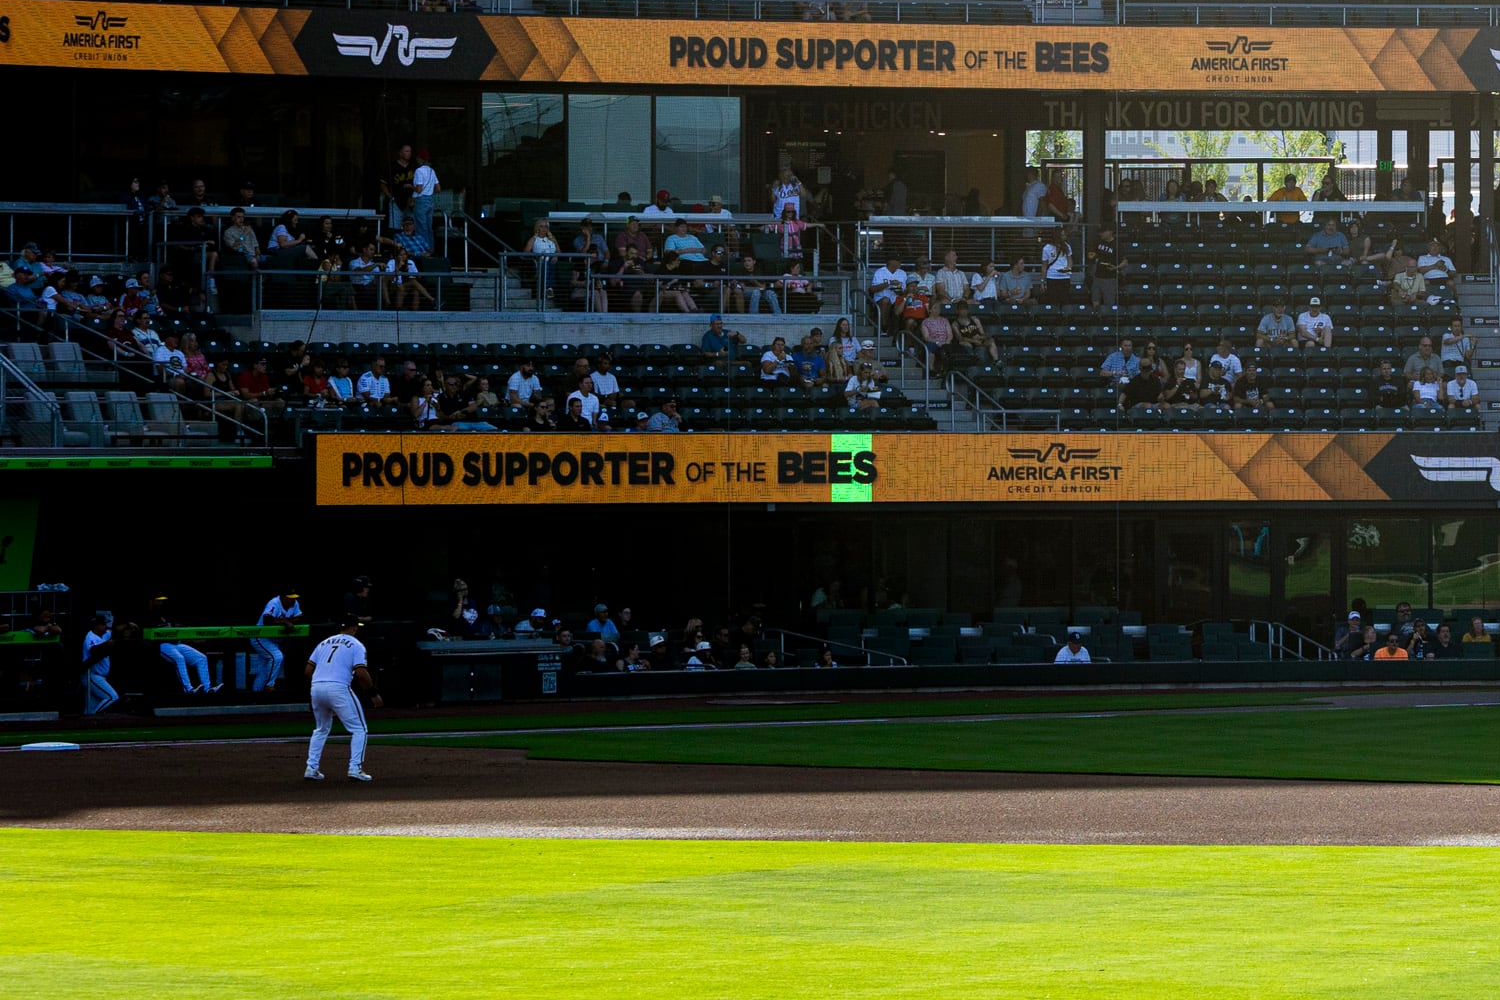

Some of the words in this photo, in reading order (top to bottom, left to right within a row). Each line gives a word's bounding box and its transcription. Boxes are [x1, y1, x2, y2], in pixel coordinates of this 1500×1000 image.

[63, 33, 107, 49] AMERICA
[108, 34, 141, 49] FIRST
[74, 52, 100, 61] CREDIT
[103, 53, 128, 62] UNION
[669, 35, 768, 69] PROUD
[775, 37, 956, 72] SUPPORTER
[963, 50, 986, 70] OF
[993, 50, 1028, 70] THE
[1035, 41, 1110, 73] BEES
[1191, 58, 1249, 71] AMERICA
[1251, 58, 1289, 71] FIRST
[1206, 75, 1239, 83] CREDIT
[1244, 75, 1273, 83] UNION
[823, 101, 944, 130] CHICKEN
[1140, 101, 1192, 128] YOU
[1200, 101, 1251, 128] FOR
[1258, 100, 1364, 128] COMING
[1380, 161, 1393, 170] EXIT
[342, 452, 455, 488] PROUD
[462, 451, 675, 487] SUPPORTER
[685, 462, 714, 482] OF
[722, 462, 766, 482] THE
[777, 451, 877, 484] BEES
[987, 466, 1067, 480] AMERICA
[1070, 466, 1122, 480] FIRST
[1007, 485, 1053, 493] CREDIT
[1062, 485, 1101, 493] UNION
[327, 645, 339, 663] 7
